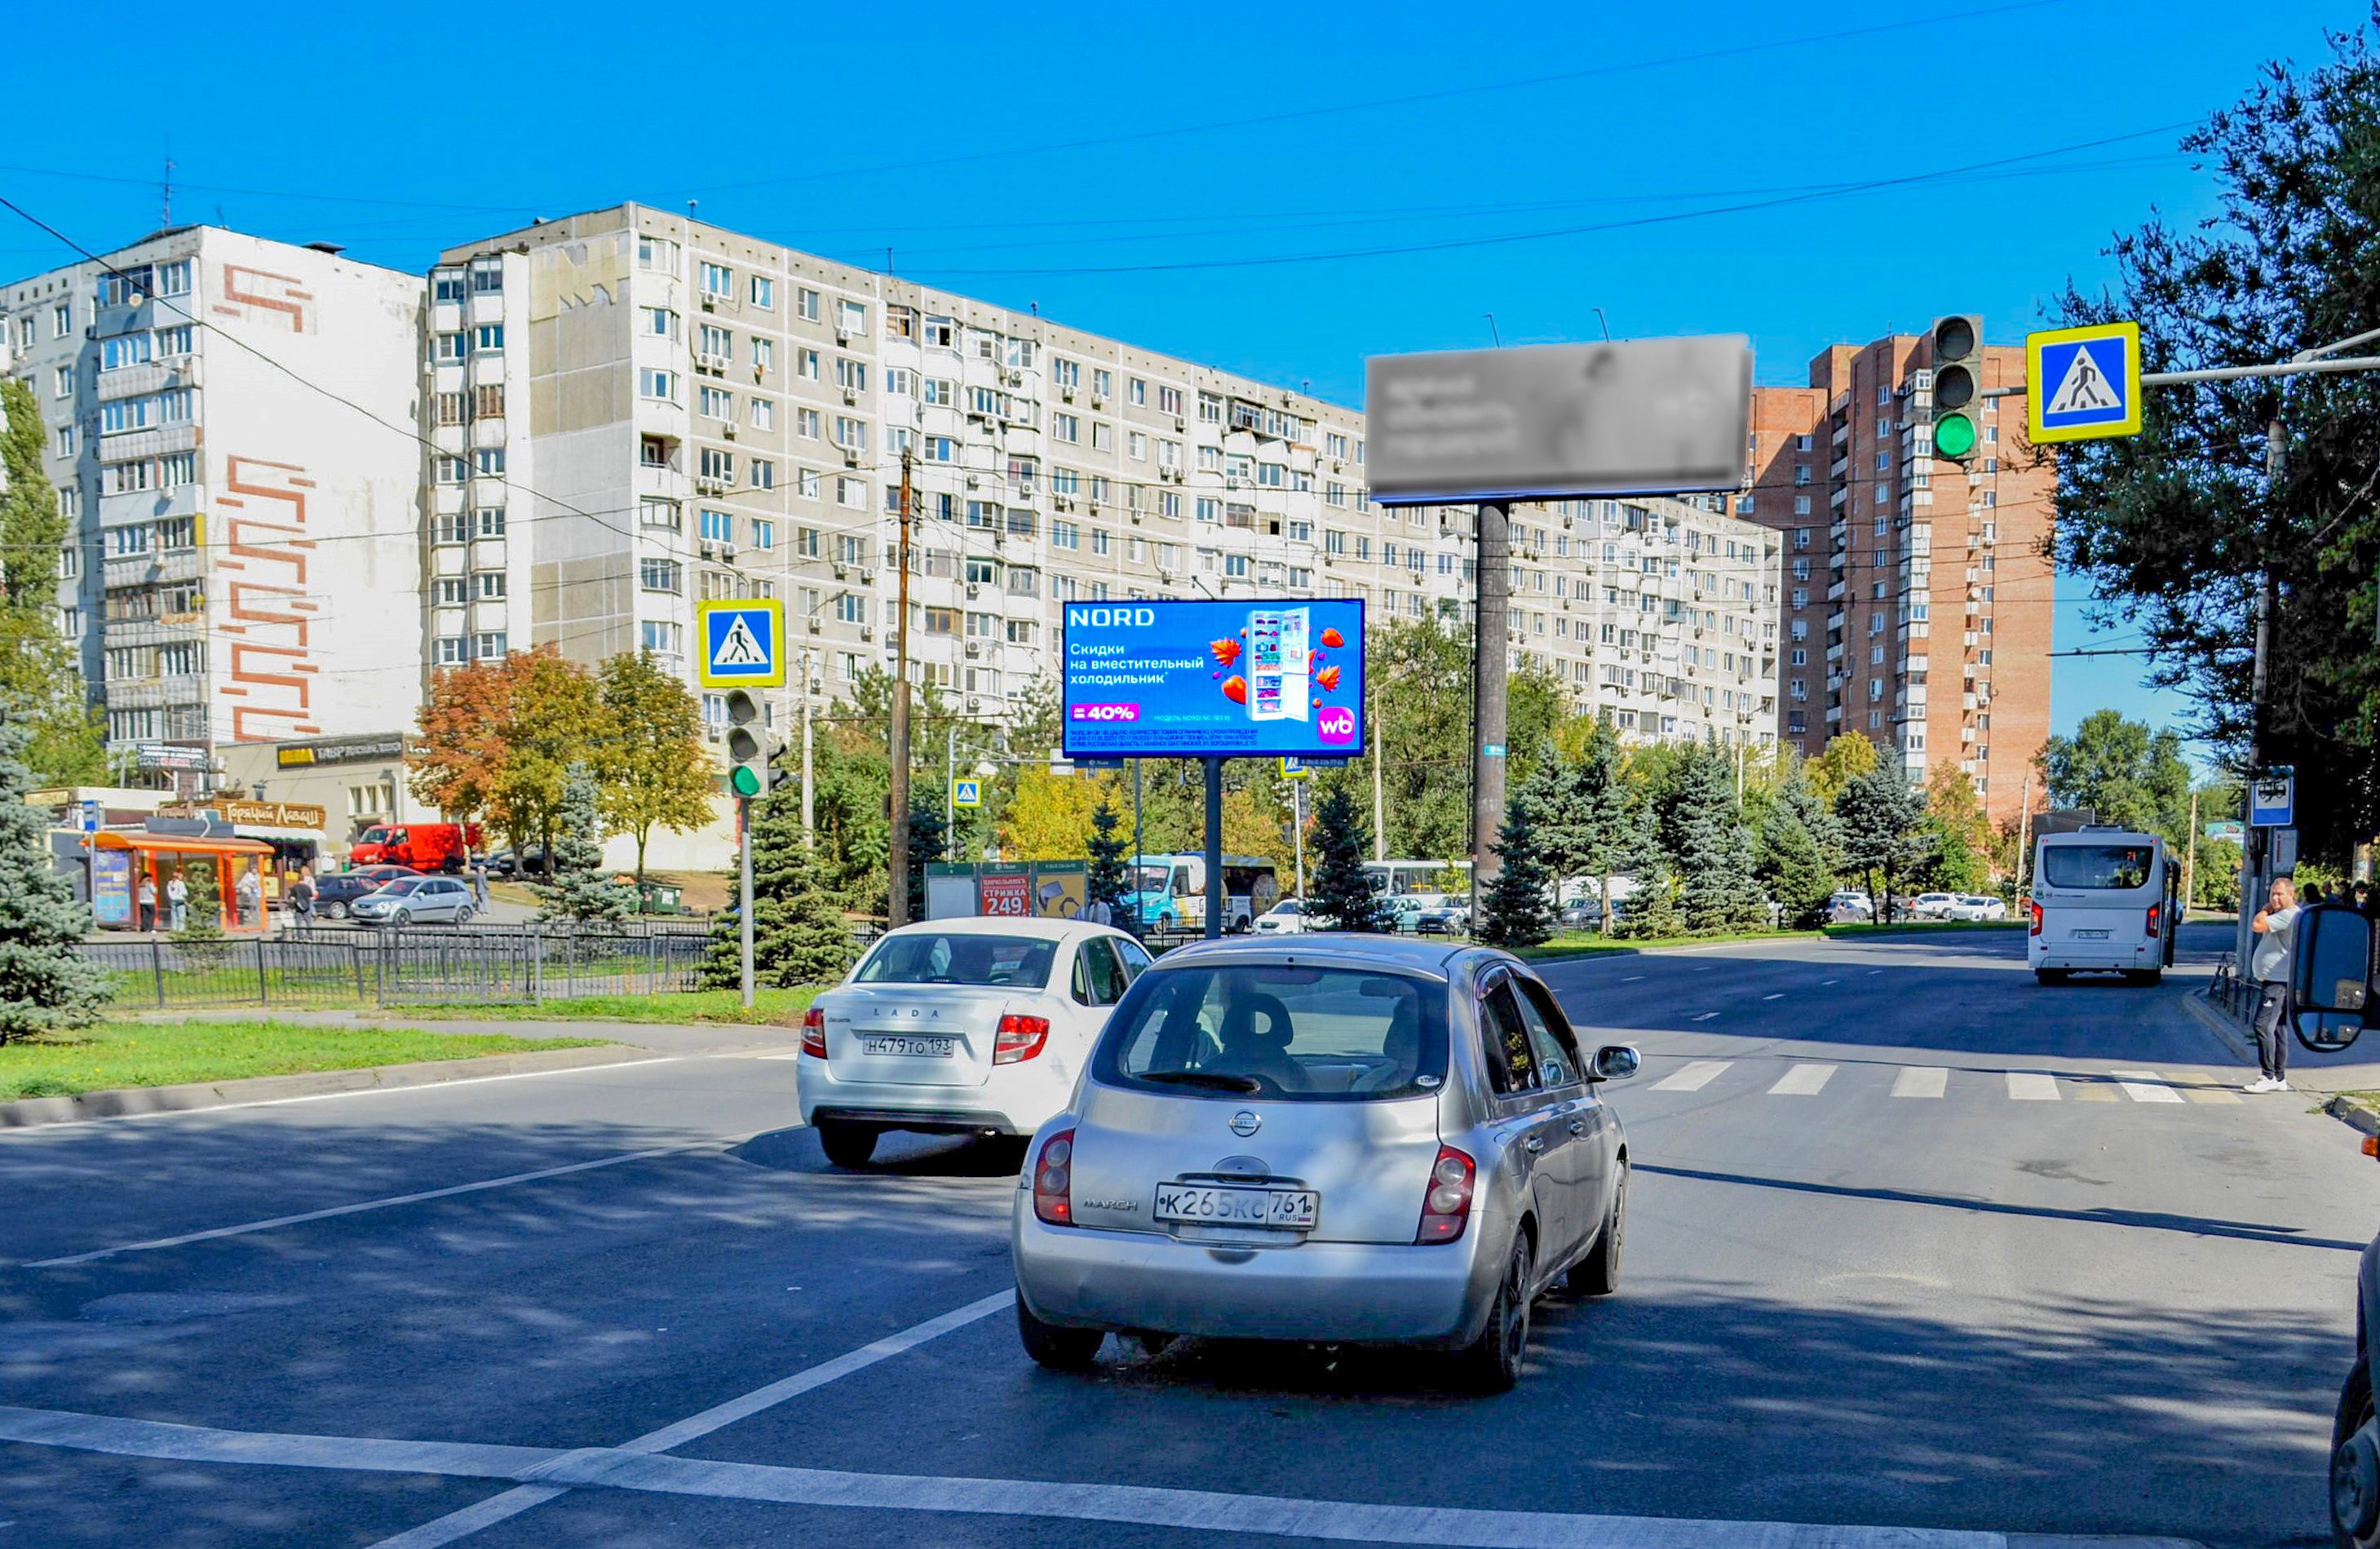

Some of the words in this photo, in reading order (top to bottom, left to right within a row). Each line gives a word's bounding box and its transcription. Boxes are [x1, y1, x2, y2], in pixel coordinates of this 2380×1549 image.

[1070, 608, 1155, 626] NORD
[1070, 643, 1125, 657] Скидки
[1070, 660, 1086, 670] на
[1091, 657, 1204, 670] вместительный
[1320, 715, 1352, 734] wb
[984, 888, 1026, 897] СТРИЖКА
[874, 1008, 939, 1017] LADA
[928, 1038, 950, 1051] 193
[1084, 1197, 1138, 1211] MARCH
[1272, 1193, 1307, 1214] 761
[1279, 1213, 1297, 1221] RUS
